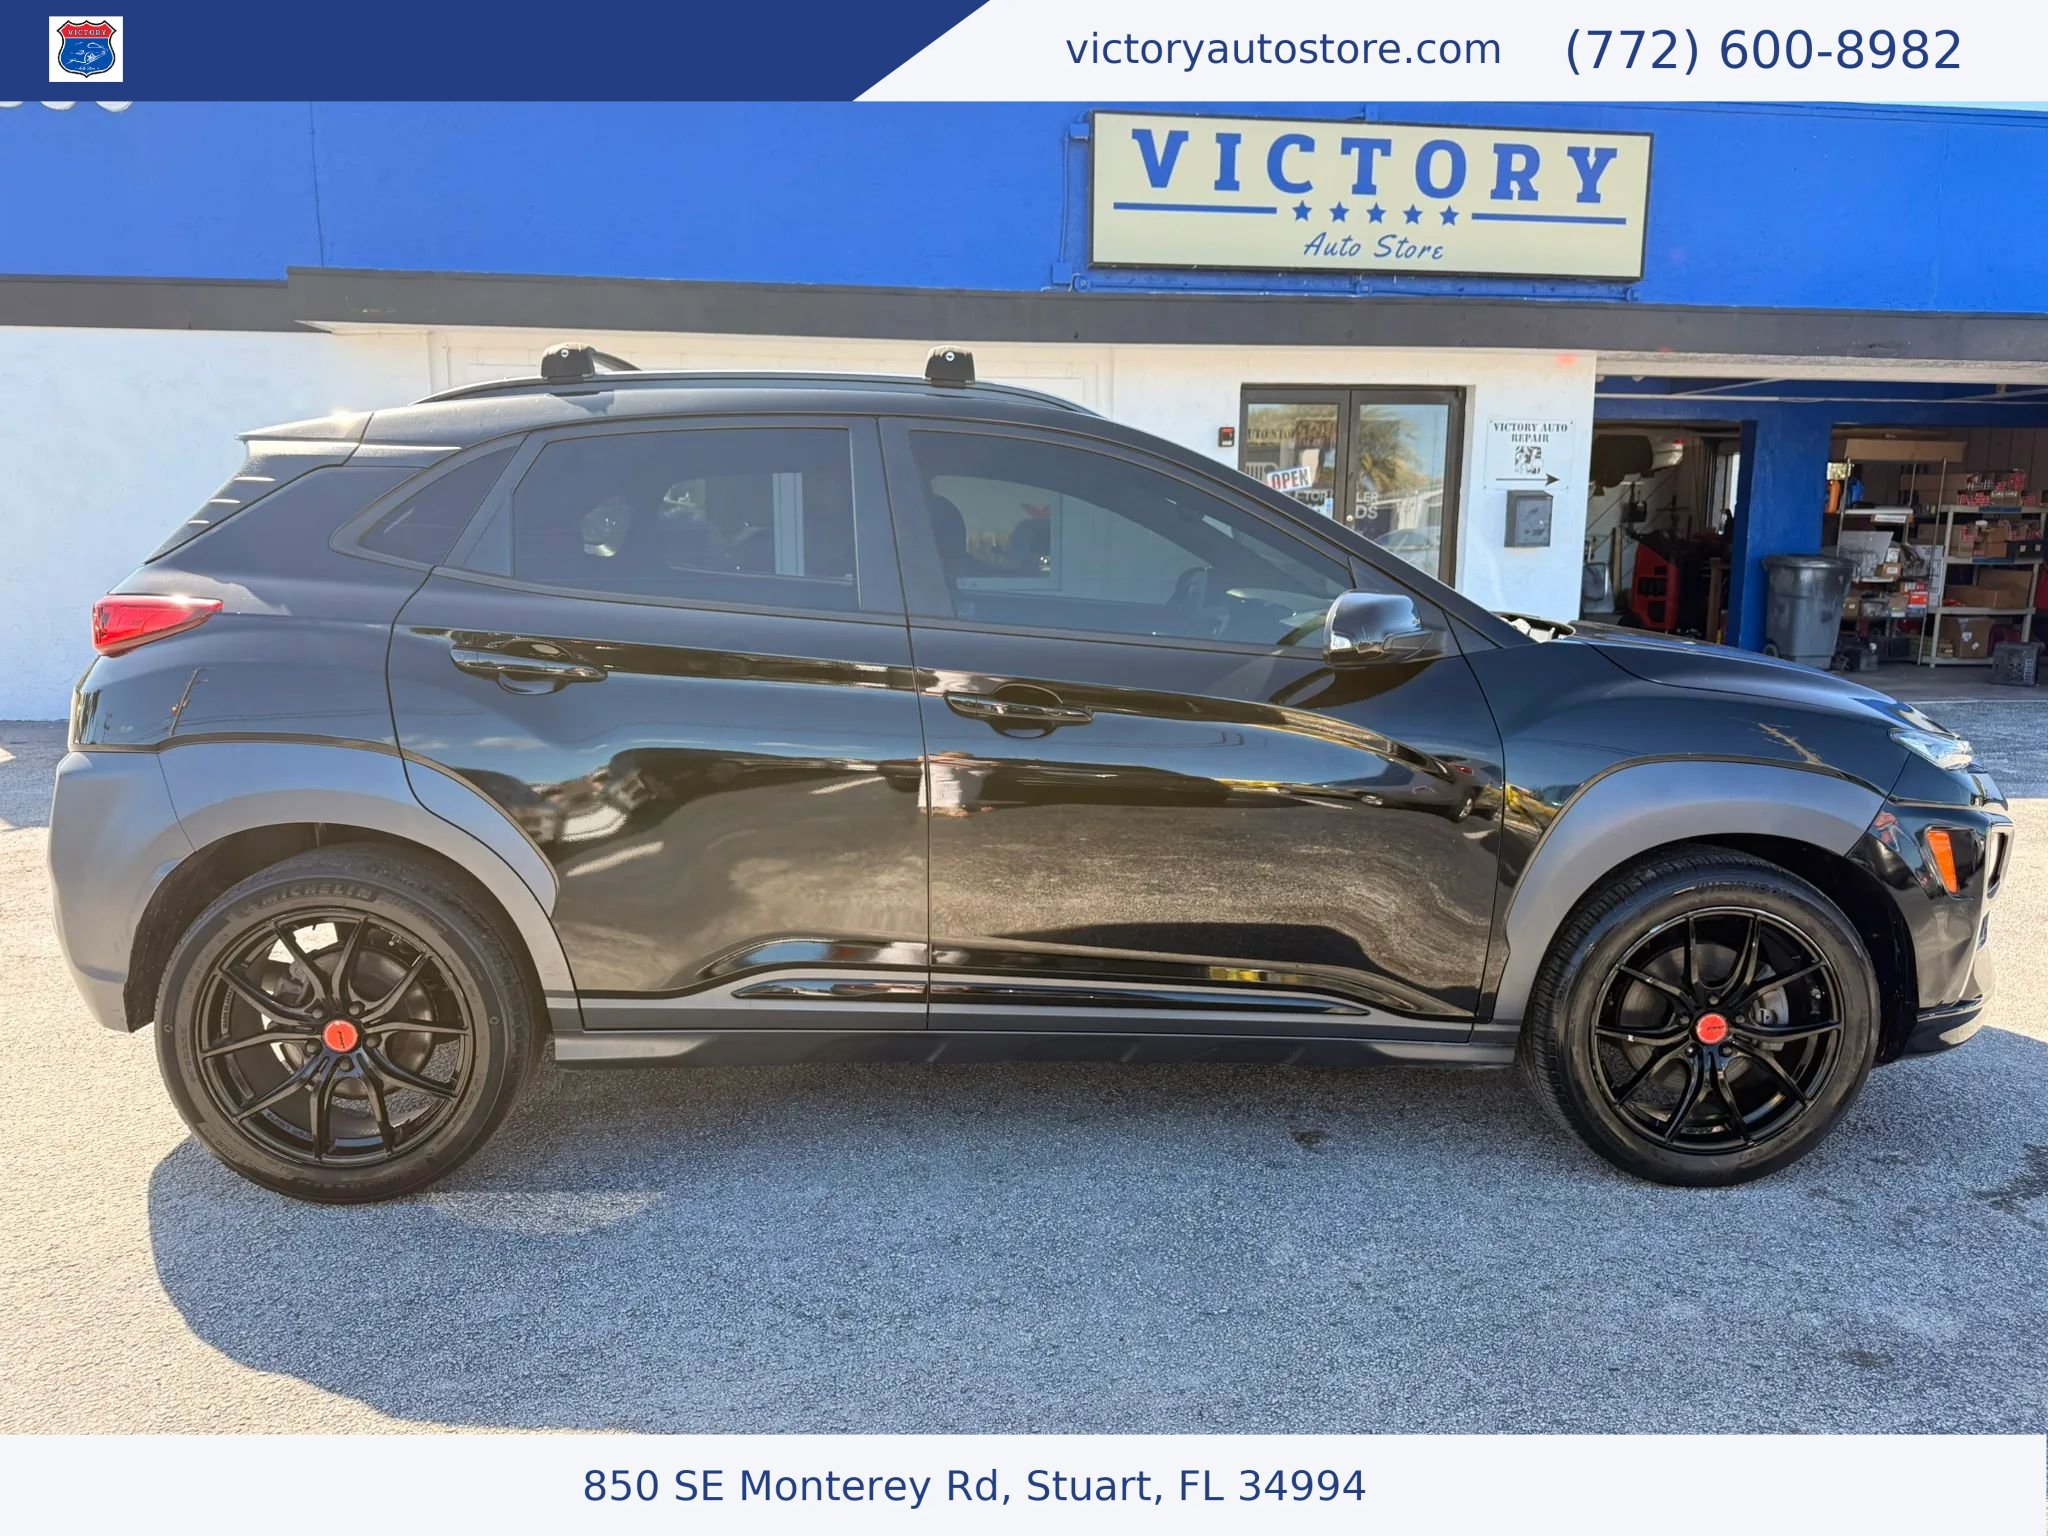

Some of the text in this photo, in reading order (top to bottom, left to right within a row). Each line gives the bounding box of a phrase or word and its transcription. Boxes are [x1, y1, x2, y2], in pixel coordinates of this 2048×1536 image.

[1131, 128, 1618, 204] VICTORY
[1303, 232, 1445, 261] Auto Store
[1493, 423, 1568, 433] VICTORY AUTO
[1511, 433, 1549, 442] REPAIR
[1271, 468, 1309, 490] OPEN
[261, 883, 373, 905] MICHELIN
